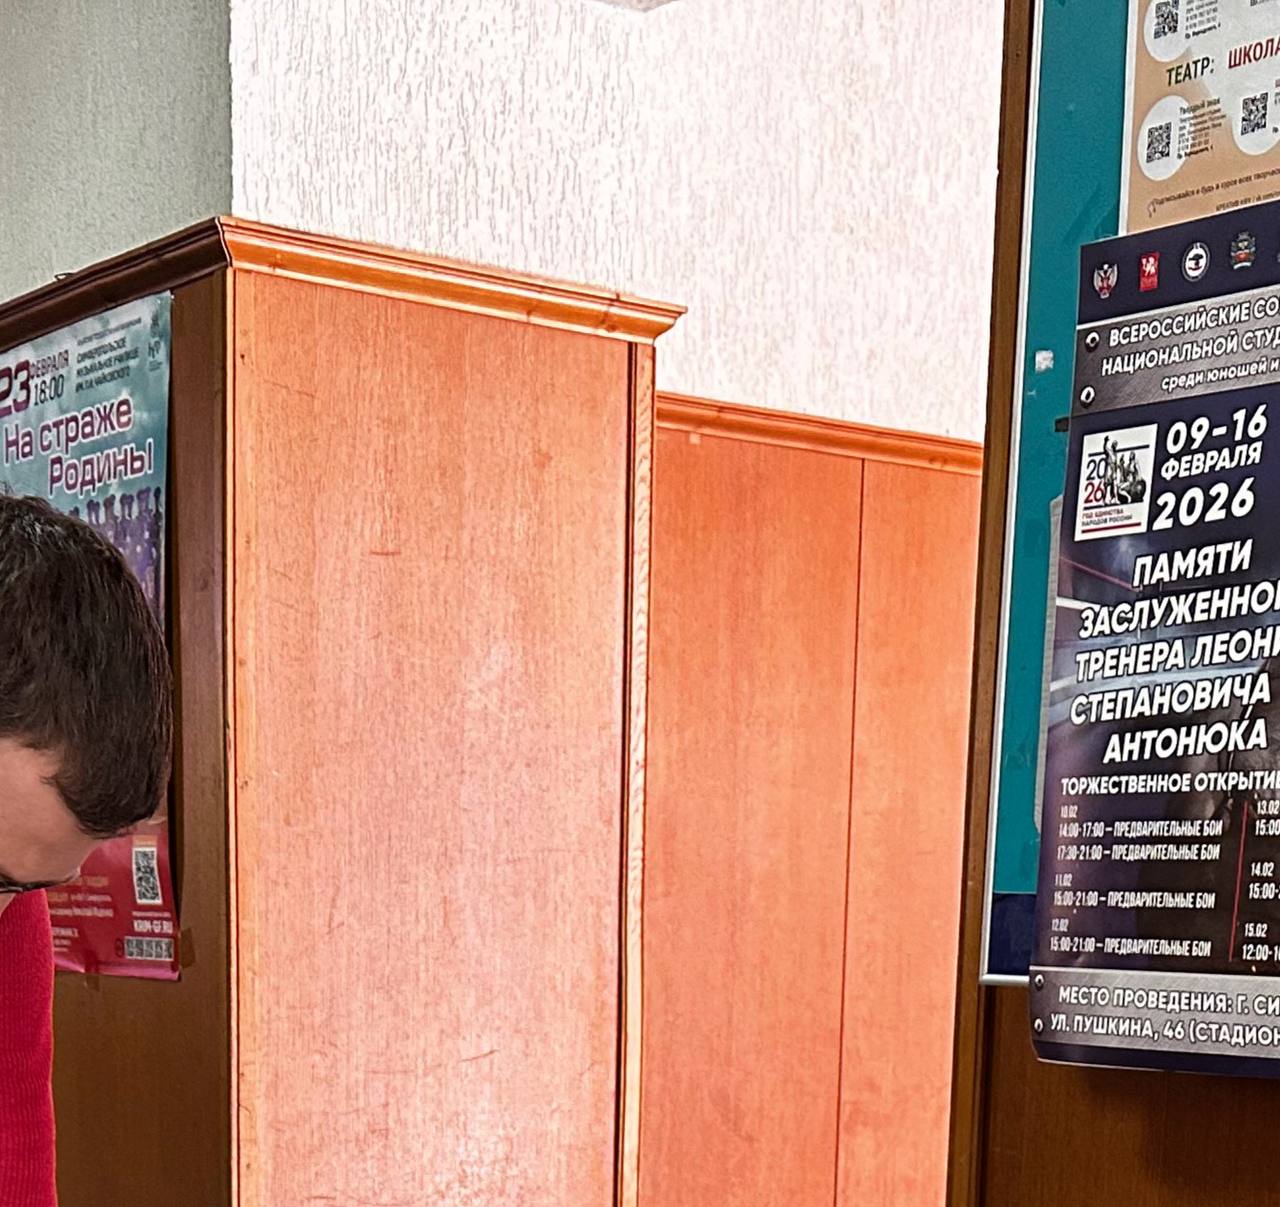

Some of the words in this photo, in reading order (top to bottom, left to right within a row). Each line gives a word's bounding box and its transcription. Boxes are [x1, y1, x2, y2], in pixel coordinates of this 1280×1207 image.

[1166, 56, 1215, 86] ТЕАТР:
[1109, 300, 1250, 347] ВСЕРОССИЙСКИЕ
[1254, 297, 1280, 319] СО
[1101, 330, 1238, 376] НАЦИОНАЛЬНОЙ
[1161, 372, 1203, 392] среди
[1206, 356, 1267, 383] юношей
[1270, 358, 1280, 372] и
[4, 423, 33, 465] На
[40, 398, 132, 455] страже
[1166, 404, 1268, 454] 09-16
[50, 441, 152, 495] Родины
[1086, 457, 1107, 482] 20
[1160, 441, 1263, 481] ФЕВРАЛЯ
[1083, 481, 1105, 504] 26
[1152, 477, 1256, 531] 2026
[1132, 539, 1253, 587] ПАМЯТИ
[1076, 639, 1185, 683] ТРЕНЕРА
[1071, 672, 1271, 726] СТЕПАНОВИЧА
[1103, 718, 1268, 764] АНТОНЮКА
[1061, 773, 1191, 796] ТОРЖЕСТВЕННОЕ
[1257, 800, 1280, 815] 13.02
[1113, 820, 1202, 838] ПРЕДВАРИТЕЛЬНЫЕ
[1203, 820, 1223, 836] БОИ
[1111, 844, 1199, 861] ПРЕДВАРИТЕЛЬНЫЕ
[1200, 844, 1221, 860] БОИ
[1251, 862, 1274, 877] 14.02
[1107, 891, 1195, 908] ПРЕДВАРИТЕЛЬНЫЕ
[1195, 892, 1216, 909] БОИ
[1249, 882, 1280, 900] 15:00-
[1244, 923, 1268, 938] 15.02
[1104, 938, 1191, 955] ПРЕДВАРИТЕЛЬНЫЕ
[1191, 940, 1211, 957] БОИ
[1059, 986, 1110, 1005] МЕСТО
[1113, 988, 1232, 1013] ПРОВЕДЕНИЯ:
[1237, 995, 1249, 1014] Г.
[1051, 1013, 1070, 1032] УЛ.
[1073, 1015, 1159, 1041] ПУШКИНА,
[1162, 1021, 1185, 1040] 46
